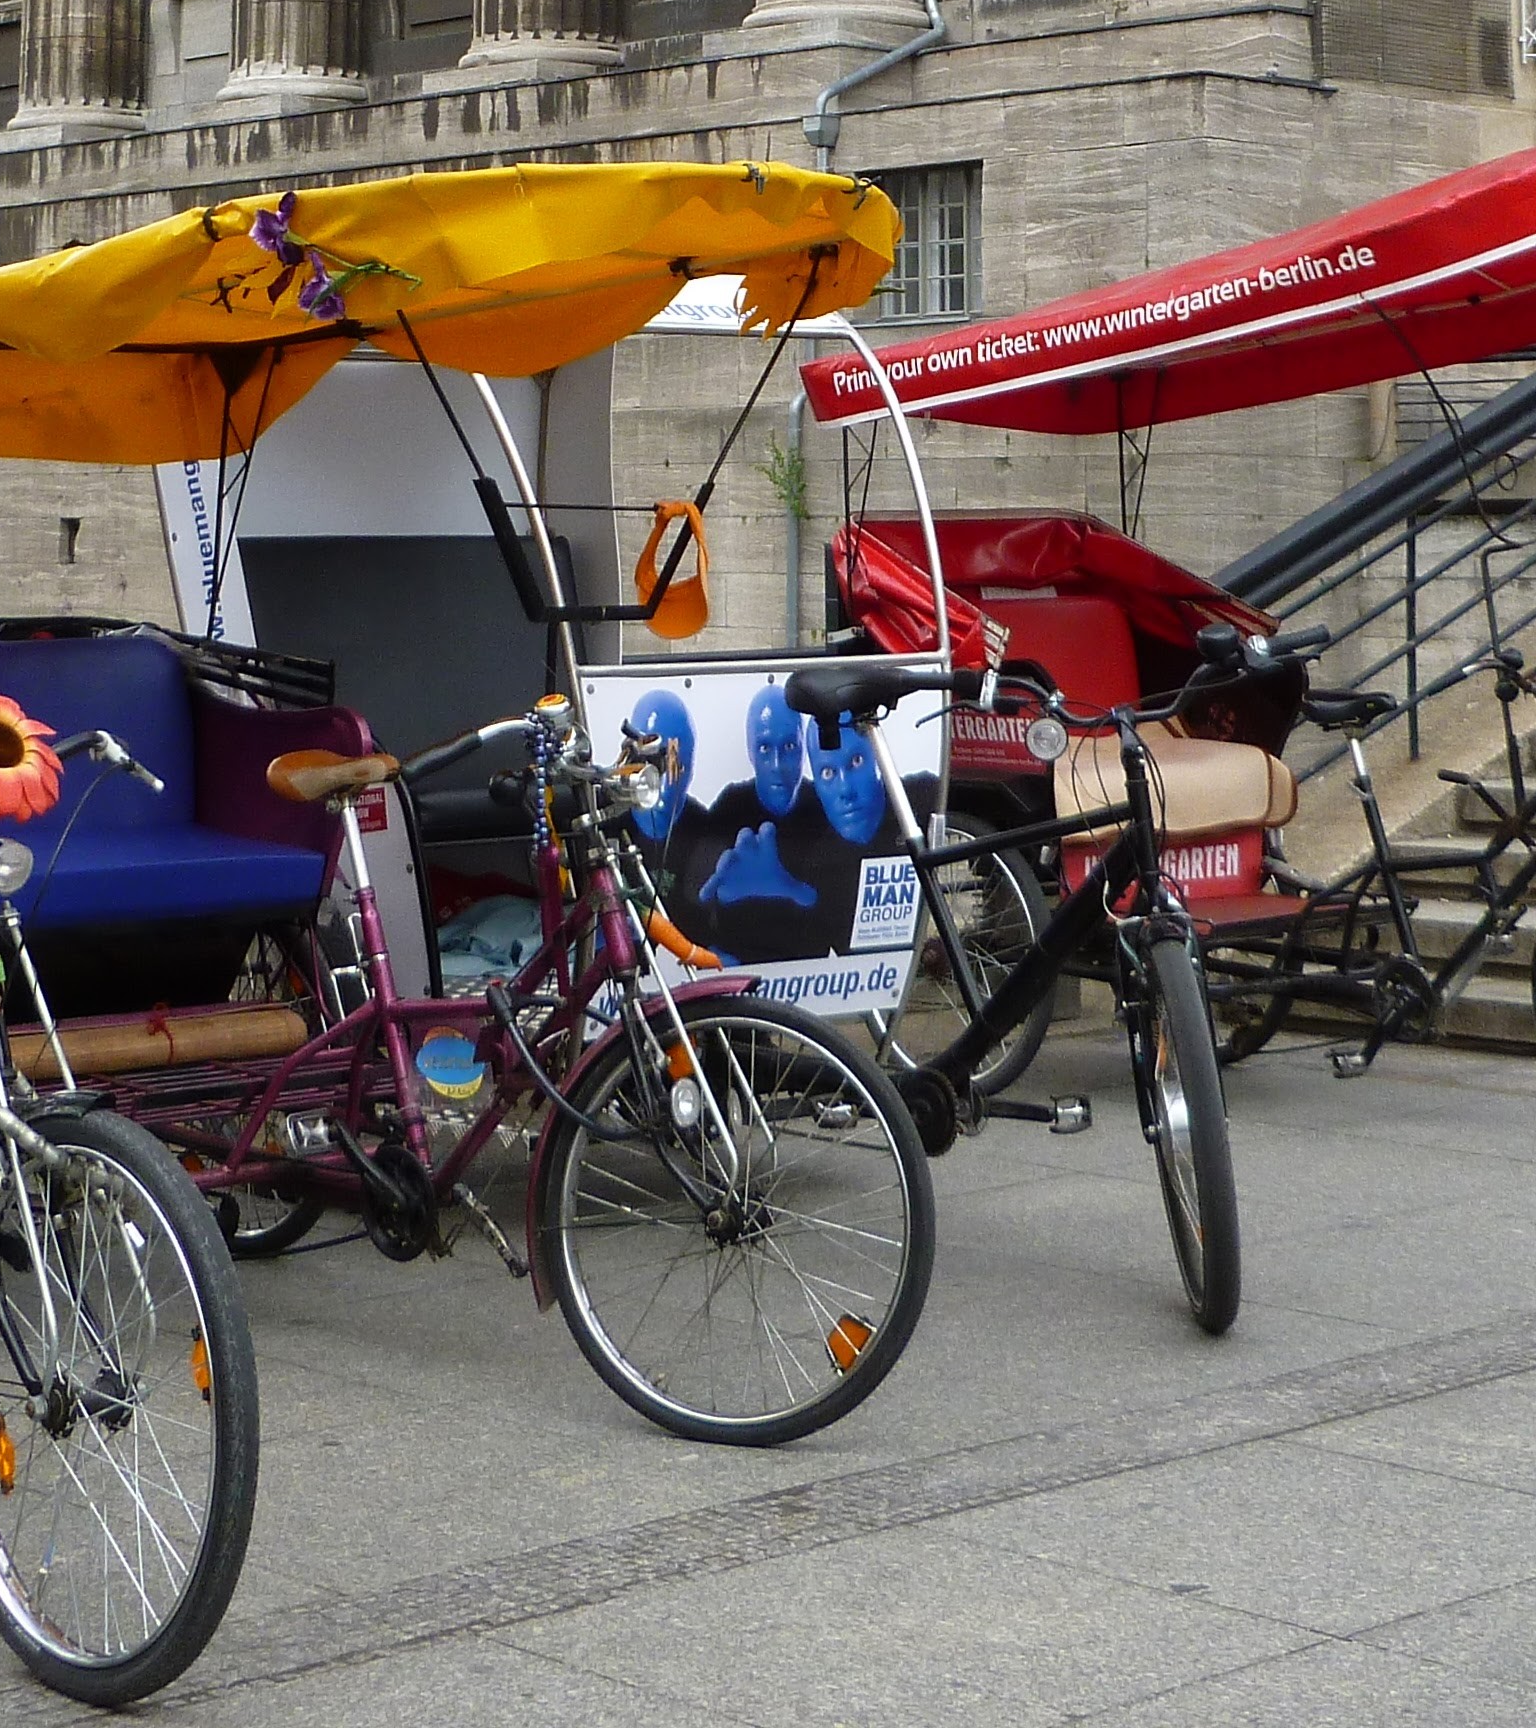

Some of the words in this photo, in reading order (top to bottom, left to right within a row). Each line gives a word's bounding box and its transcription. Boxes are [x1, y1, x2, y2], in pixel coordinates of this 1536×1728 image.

[927, 346, 972, 372] own
[977, 331, 1040, 363] ticket:
[1042, 244, 1376, 348] www.wintergarten-berlin.de
[865, 863, 916, 885] BLUE
[862, 883, 915, 908] MAN
[860, 905, 913, 923] GROUP
[756, 962, 897, 1005] angroup.de
